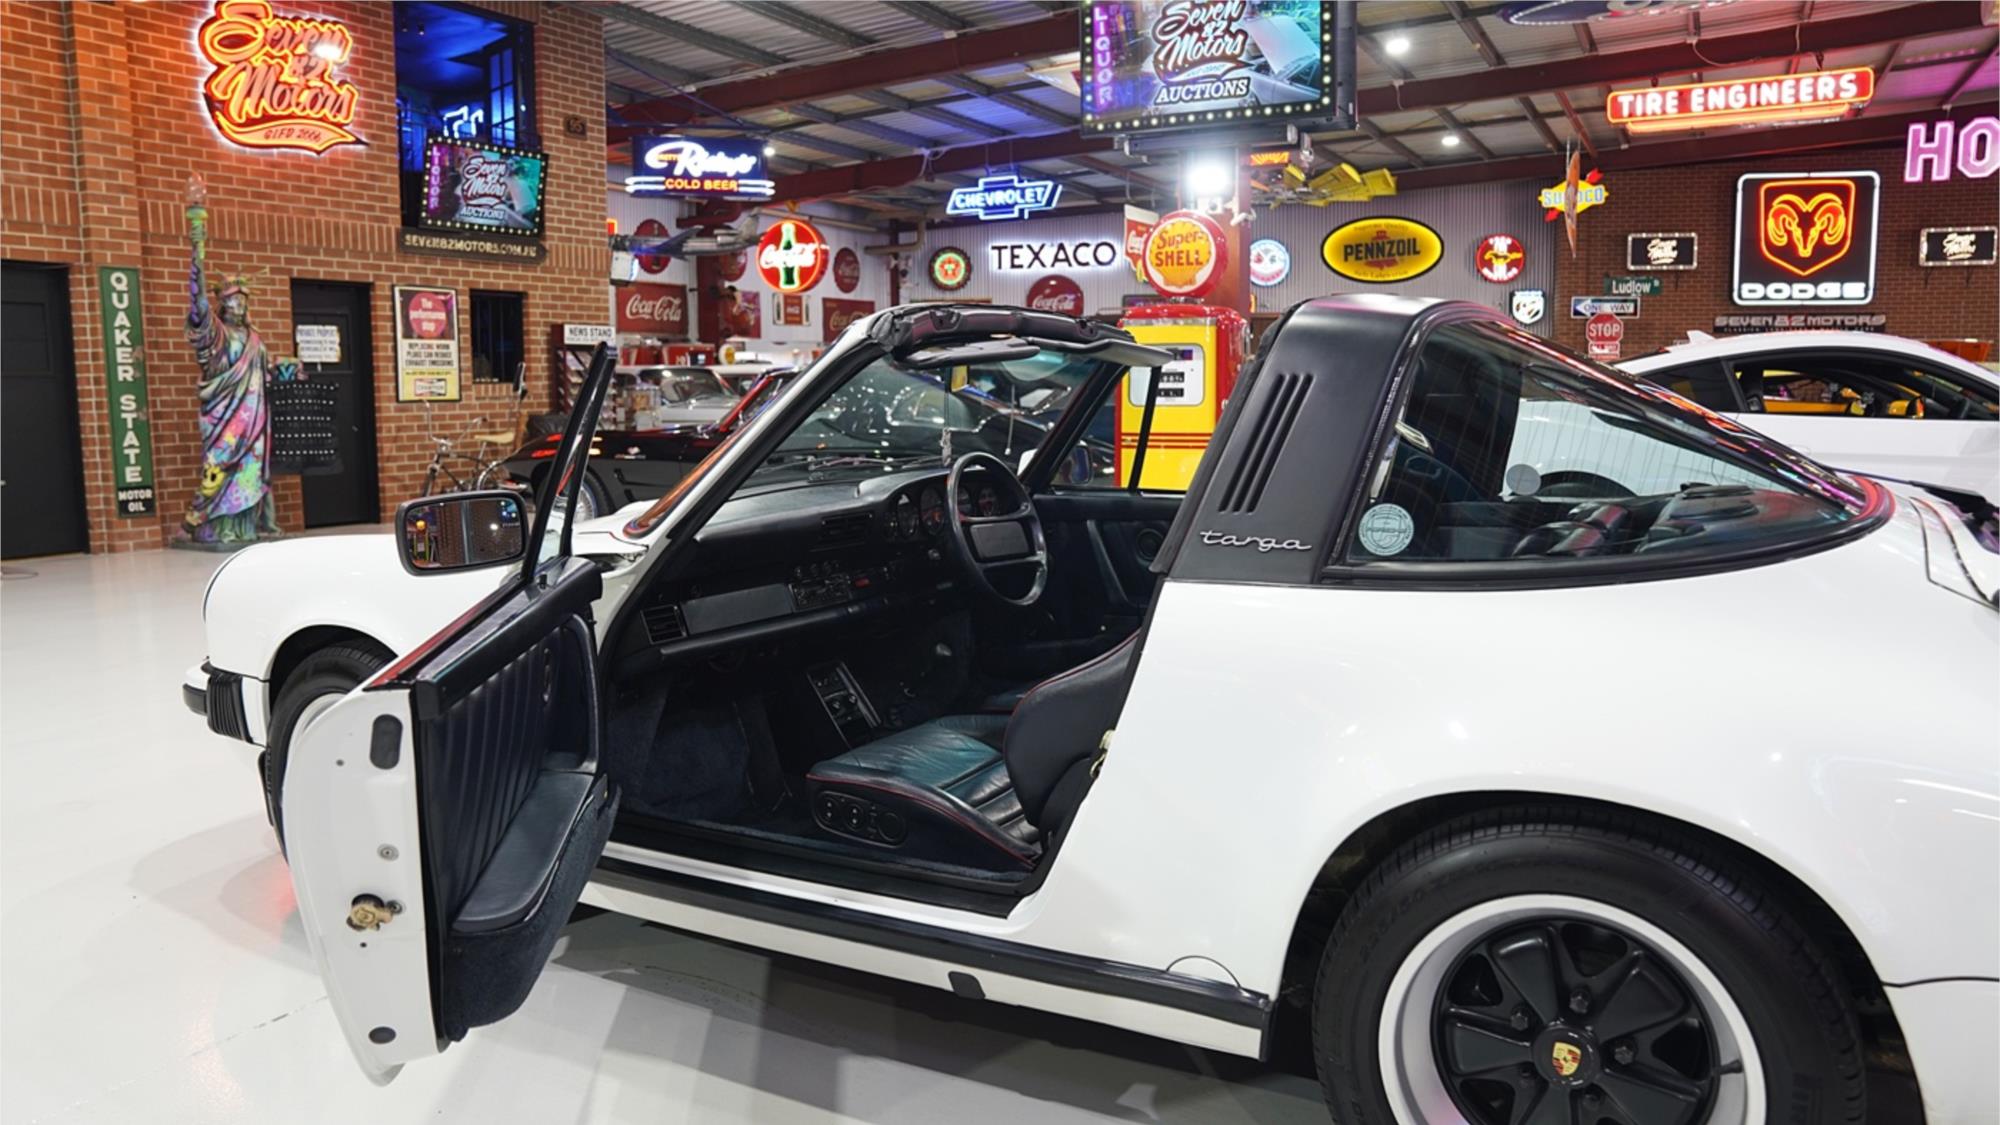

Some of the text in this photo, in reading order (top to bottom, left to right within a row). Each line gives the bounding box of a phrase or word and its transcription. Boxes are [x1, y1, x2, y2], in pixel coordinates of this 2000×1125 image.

[204, 0, 352, 64] Seven
[1156, 0, 1243, 40] Seven
[1093, 7, 1113, 105] LIQUOR
[1158, 32, 1245, 72] Motors
[212, 61, 358, 123] Motors
[1155, 79, 1249, 103] AUCTIONS
[1617, 73, 1858, 118] TIRE ENGINEERS
[1903, 116, 1999, 183] HO
[429, 145, 441, 210] LIQUOR
[665, 179, 738, 192] COLD BEER
[955, 187, 1045, 208] CHEVROLET
[991, 242, 1117, 270] TEXACO
[1155, 249, 1204, 268] SHELL
[1343, 237, 1421, 263] PENNZOIL
[1612, 280, 1652, 294] Ludlow
[1740, 282, 1866, 299] DODGE
[1610, 303, 1631, 311] WAY
[569, 327, 612, 337] NEWS STAND
[1589, 323, 1620, 337] STOP
[1714, 316, 1773, 327] SEVEN
[1807, 315, 1886, 327] MOTORS
[110, 271, 143, 484] QUAKER STATE
[118, 488, 153, 501] MOTOR
[128, 501, 146, 513] OIL
[1200, 529, 1313, 553] targa
